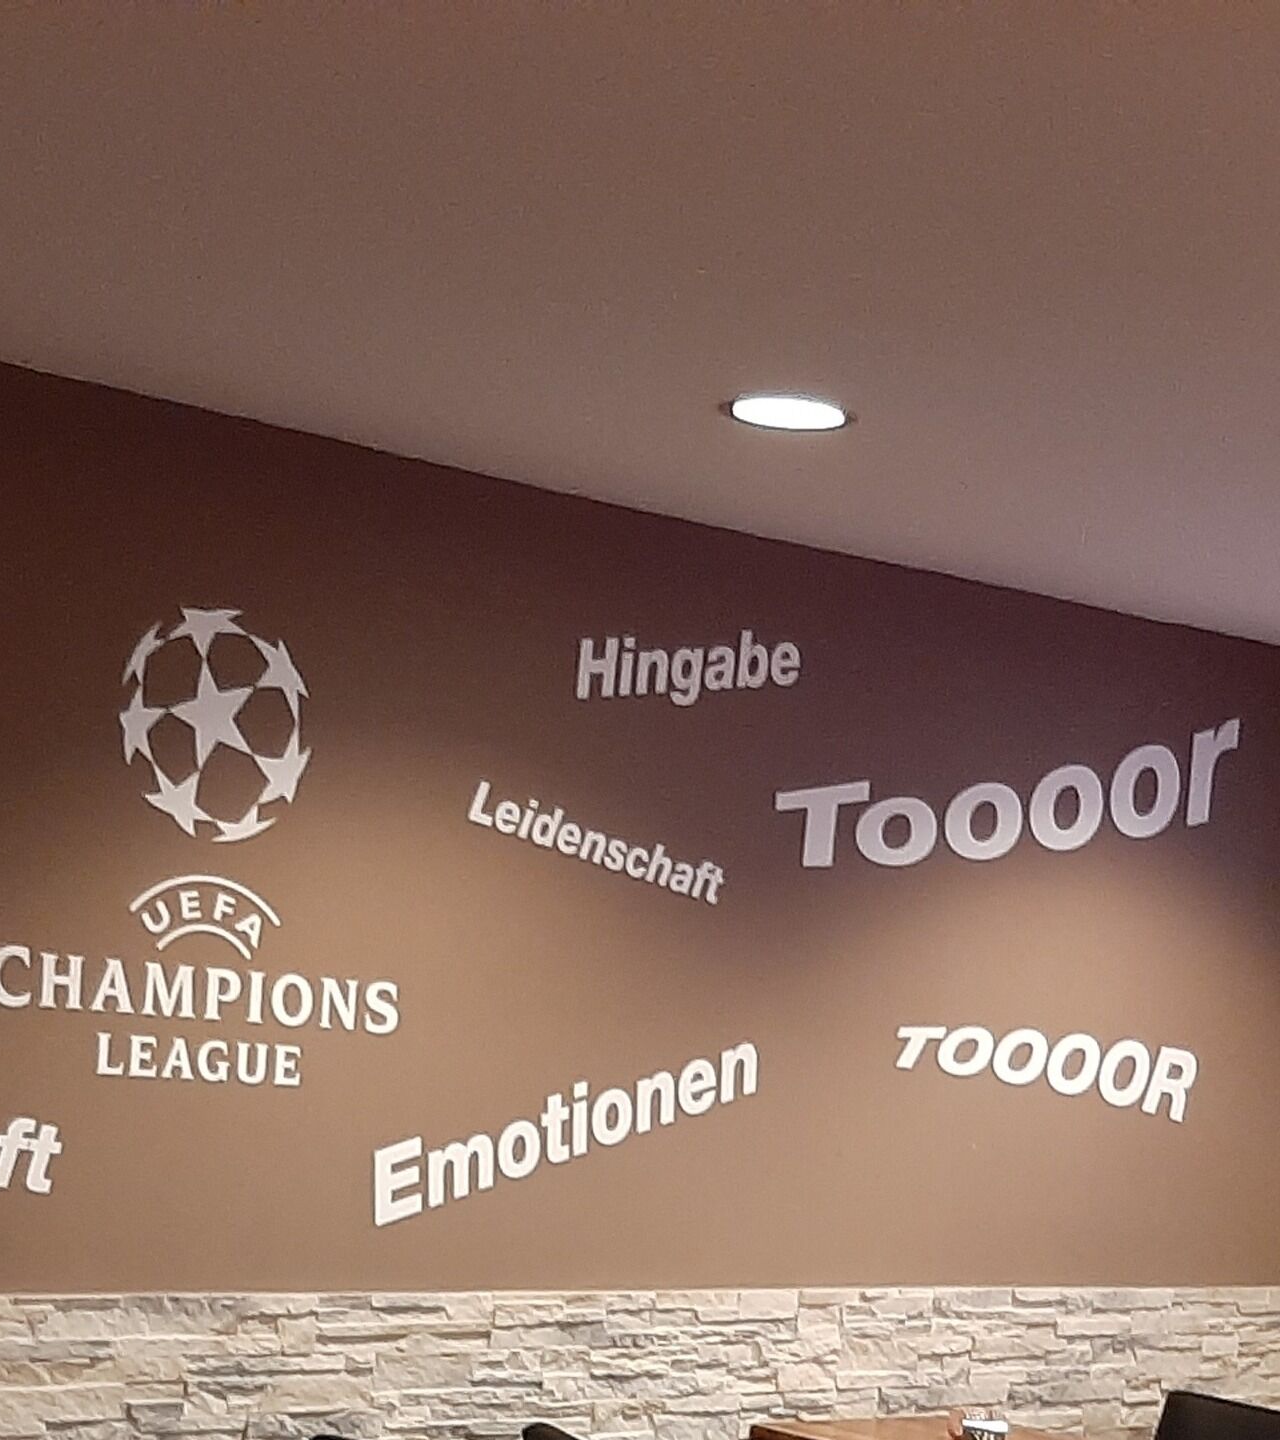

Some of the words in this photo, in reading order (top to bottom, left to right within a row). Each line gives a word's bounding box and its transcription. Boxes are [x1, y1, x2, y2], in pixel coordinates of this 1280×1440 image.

[576, 629, 802, 707] Hingabe
[467, 780, 725, 905] Leidenschaft
[774, 717, 1242, 869] Toooor
[140, 889, 266, 948] UEFA
[95, 1032, 303, 1088] LEAGUE
[895, 1024, 1200, 1123] TOOOOR
[373, 1040, 760, 1227] Emotionen
